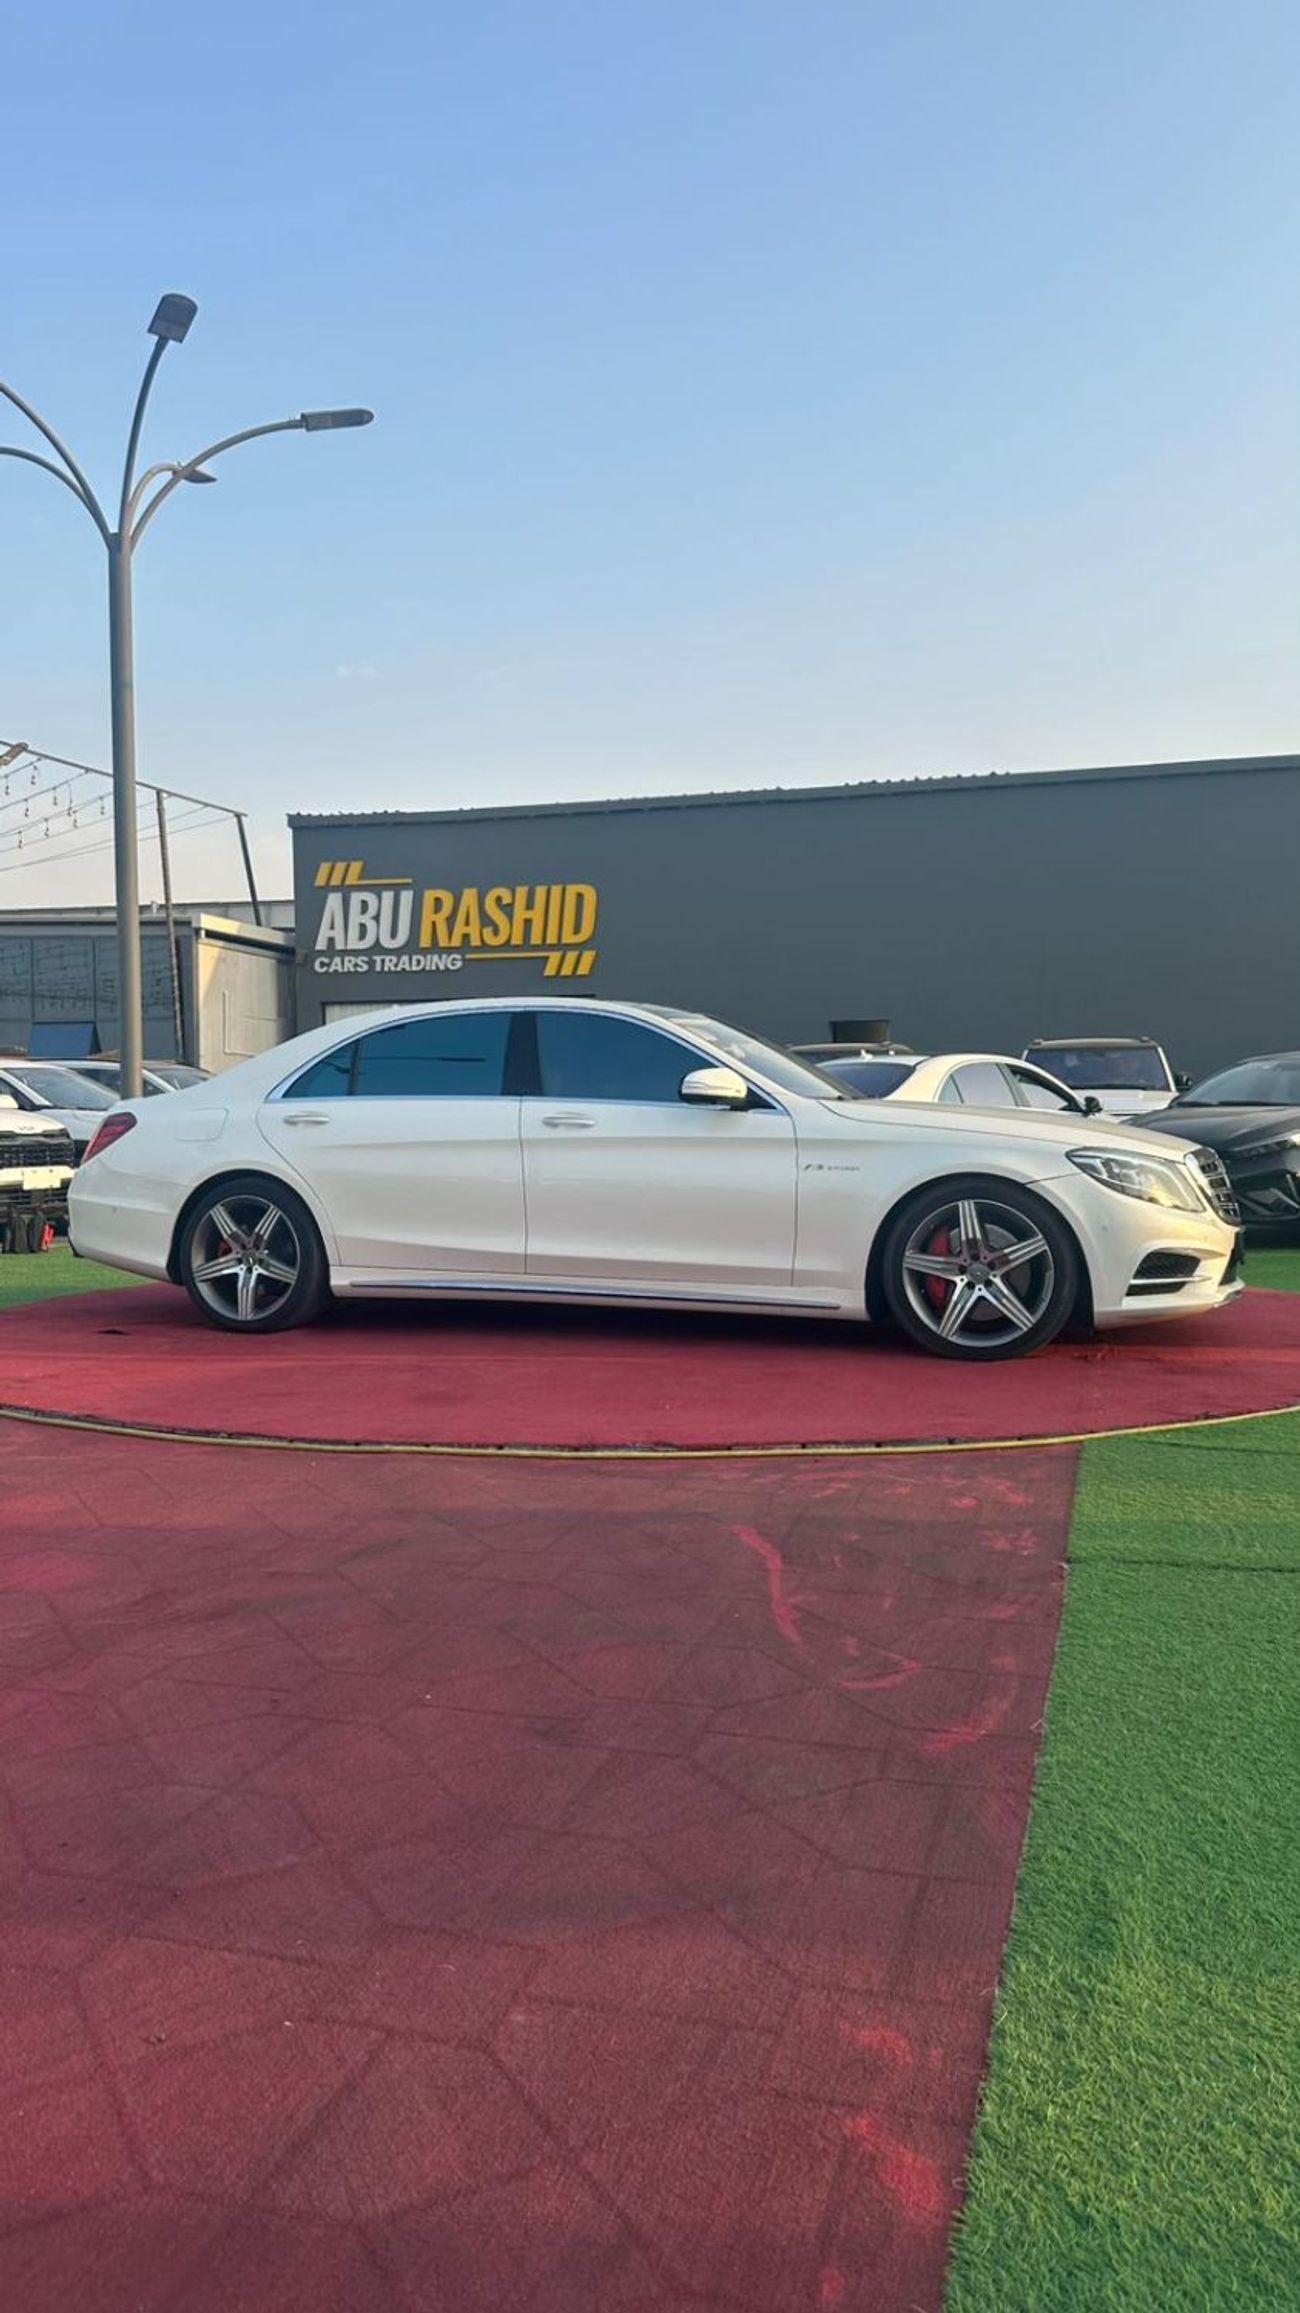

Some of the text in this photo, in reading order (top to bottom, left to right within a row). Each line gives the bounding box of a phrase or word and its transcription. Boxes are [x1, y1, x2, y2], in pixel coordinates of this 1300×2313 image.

[315, 883, 597, 951] ABU RASHID
[314, 953, 463, 974] CARS TRADING
